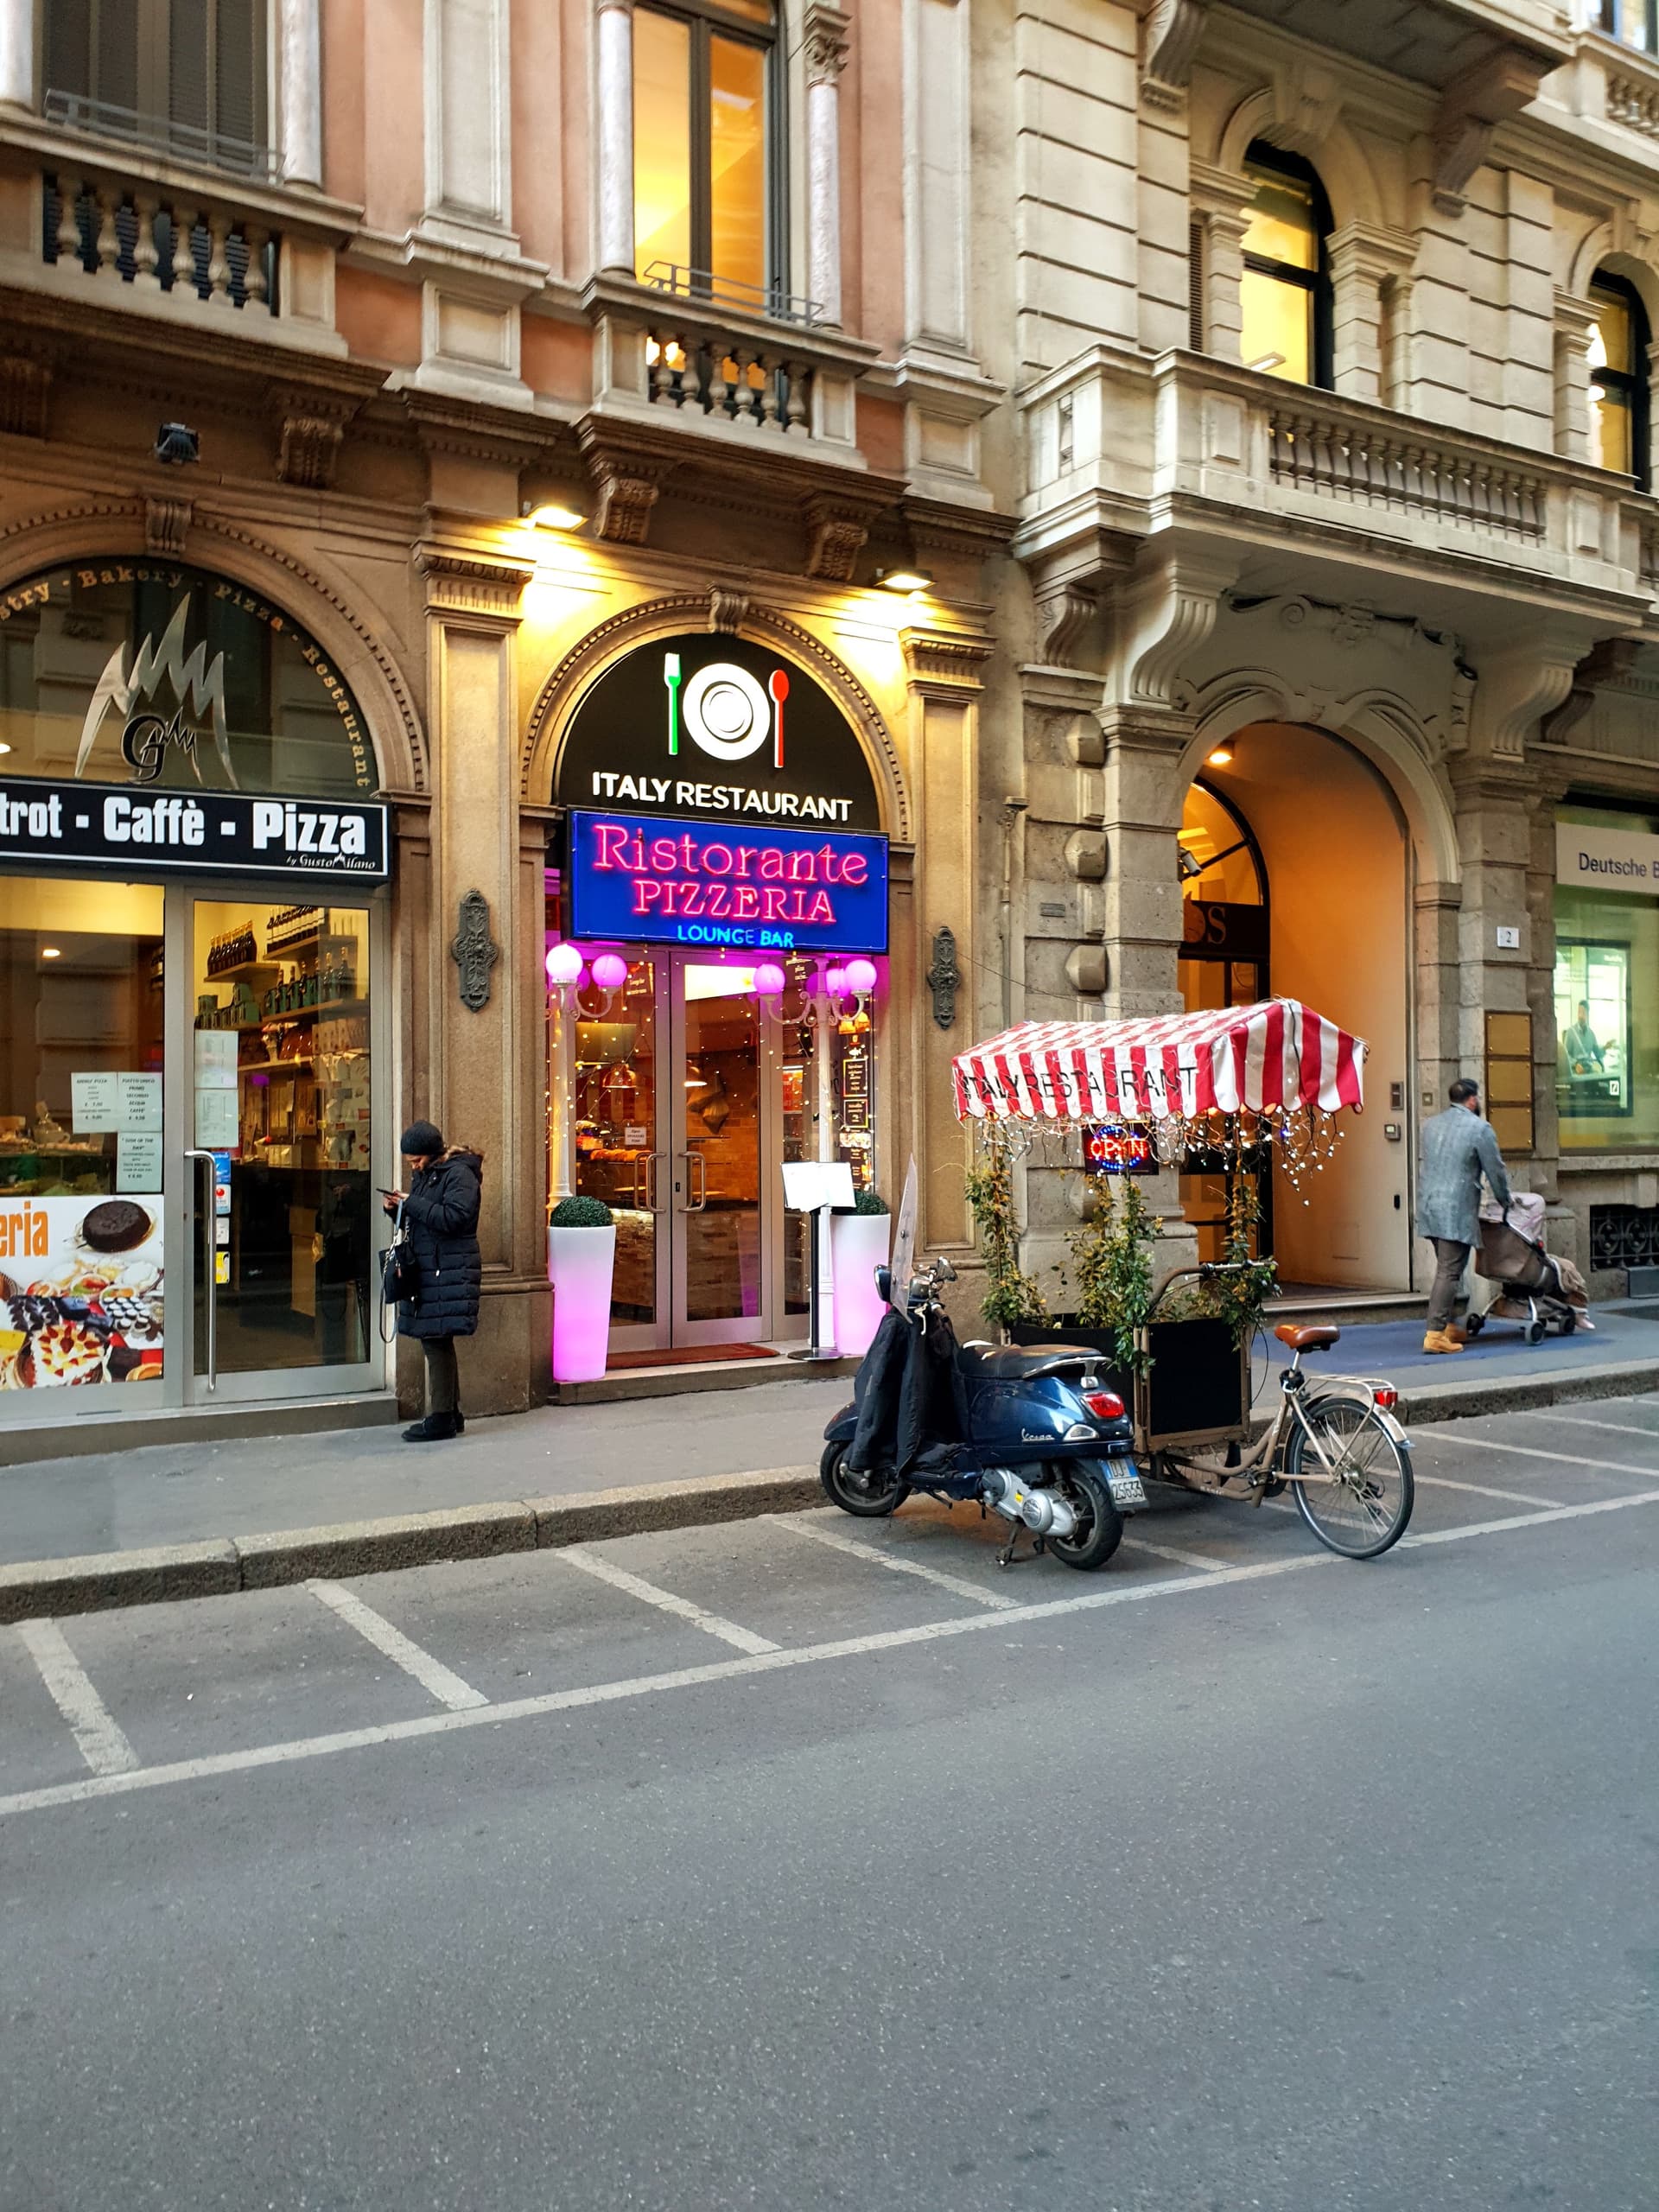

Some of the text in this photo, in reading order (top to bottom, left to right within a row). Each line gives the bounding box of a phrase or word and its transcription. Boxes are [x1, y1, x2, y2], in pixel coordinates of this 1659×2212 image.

[77, 565, 184, 588] Bakery
[215, 583, 284, 632] Pizza
[302, 644, 371, 787] Restaurant
[592, 772, 853, 821] ITALY RESTAURANT
[103, 795, 205, 846] Caffè
[252, 801, 365, 855] Pizza
[593, 825, 868, 885] Ristorante
[1579, 852, 1647, 877] Deutsche
[632, 879, 837, 924] PIZZERIA
[677, 925, 795, 948] LOUNGE BAR
[1026, 1066, 1199, 1098] RESTAURANT
